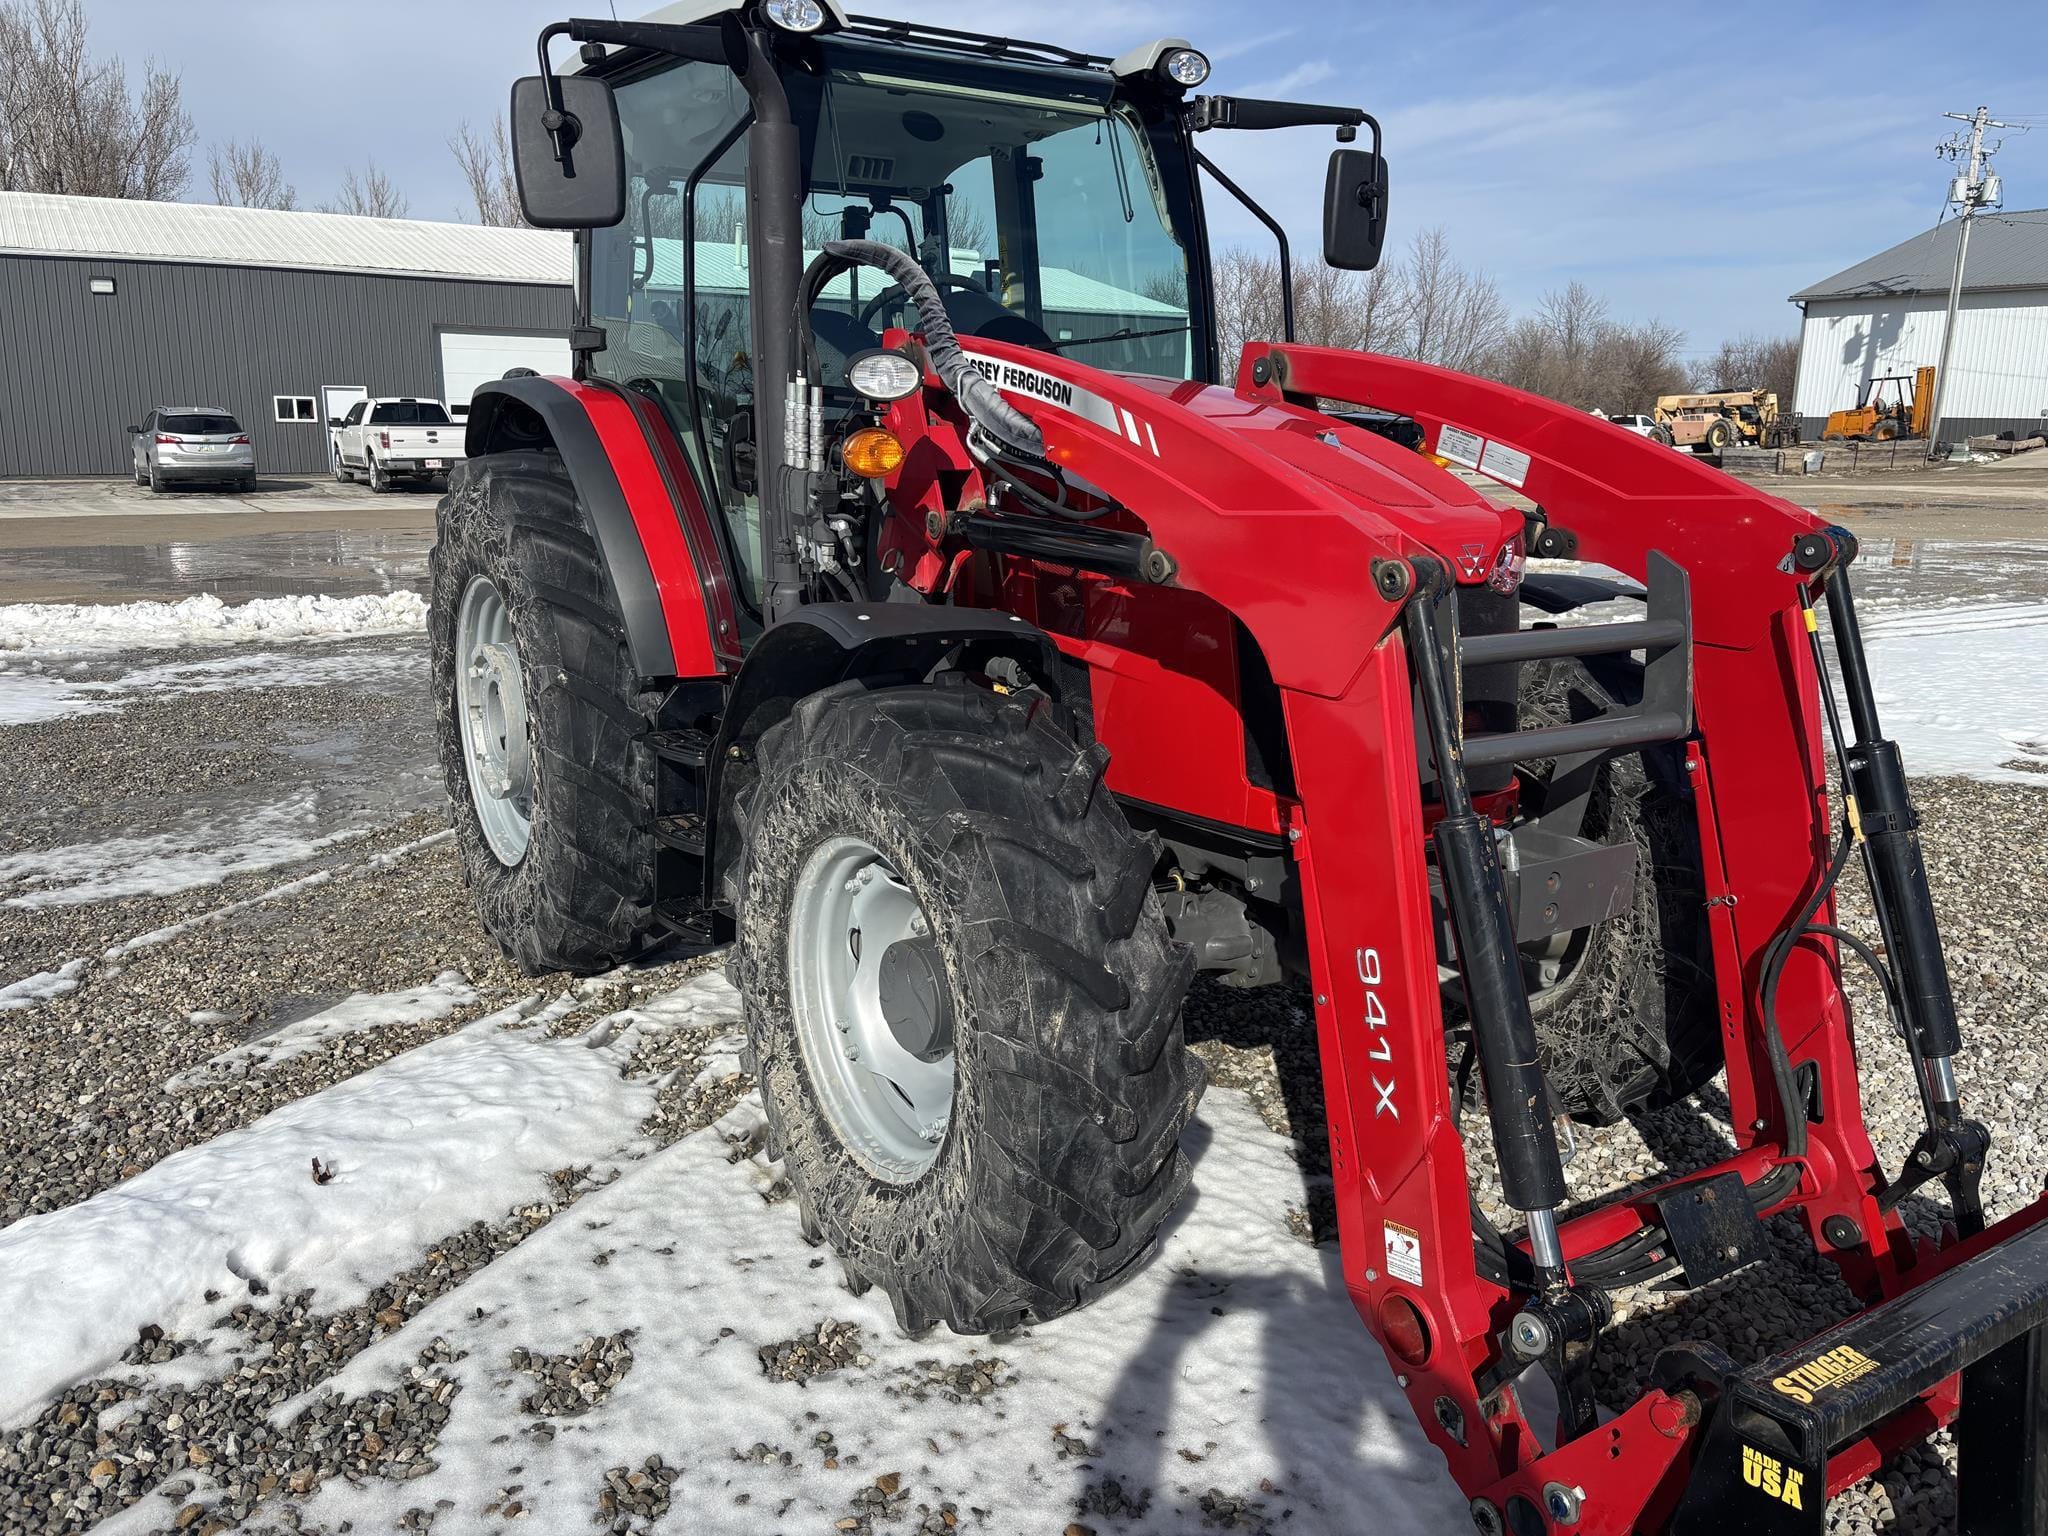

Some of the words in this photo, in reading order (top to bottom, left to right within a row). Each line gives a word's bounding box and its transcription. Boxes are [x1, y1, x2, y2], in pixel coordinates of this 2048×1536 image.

[965, 358, 1000, 382] SSEY
[1003, 366, 1072, 407] FERGUSON
[1356, 947, 1399, 1122] 941X
[1390, 1223, 1418, 1239] WARNING
[1772, 1345, 1868, 1404] STINGER
[1743, 1444, 1781, 1475] MADE
[1788, 1467, 1804, 1486] IN
[1743, 1456, 1803, 1511] USA
